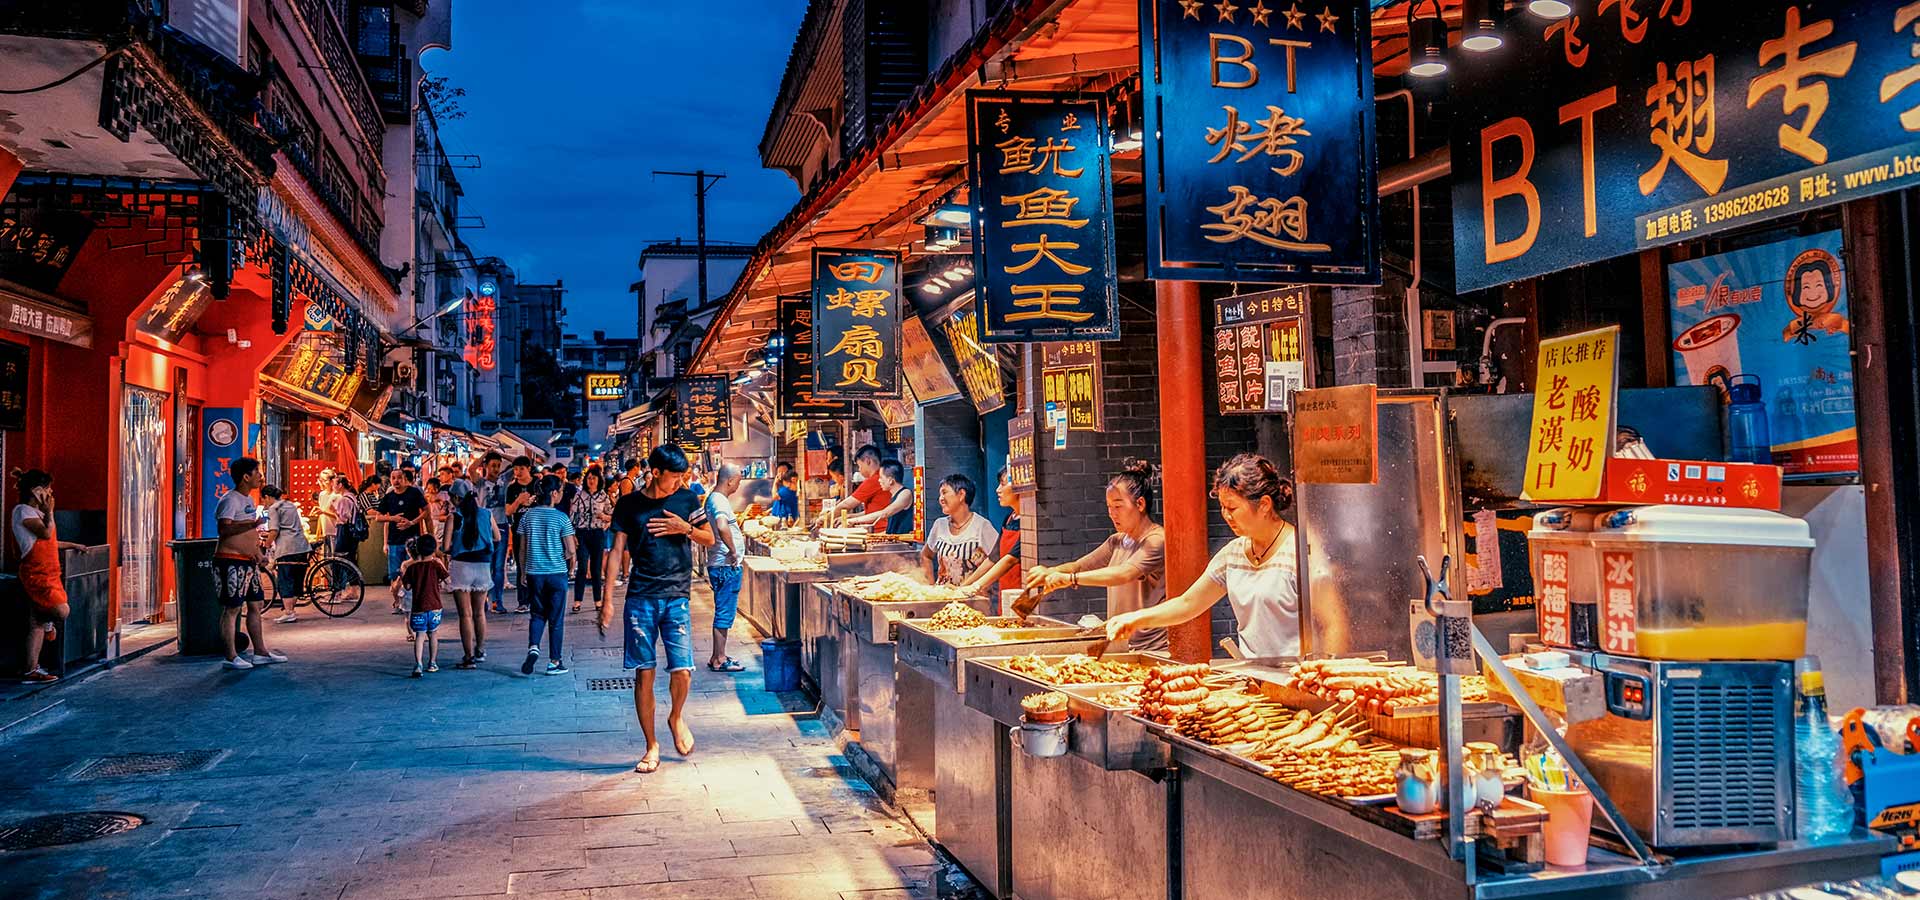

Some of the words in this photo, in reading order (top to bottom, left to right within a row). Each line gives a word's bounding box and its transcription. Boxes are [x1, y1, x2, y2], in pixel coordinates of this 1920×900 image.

[1209, 33, 1312, 94] BT
[994, 109, 1081, 134] 专业
[1200, 105, 1332, 252] 烤翅
[1703, 186, 1789, 223] 13986282628
[995, 137, 1094, 322] 鱿鱼大王
[825, 262, 892, 388] 田螺扇贝
[1247, 294, 1298, 315] 今日特色
[1241, 326, 1264, 402] 鱿鱼片
[1545, 339, 1607, 368] 店长推荐
[689, 394, 720, 437] 特色猪手
[1536, 374, 1571, 490] 老漢口
[1566, 385, 1601, 473] 酸奶
[1629, 474, 1647, 493] 福
[1743, 480, 1759, 498] 福
[1542, 554, 1568, 645] 酸梅汤
[1606, 556, 1634, 652] 水果汁
